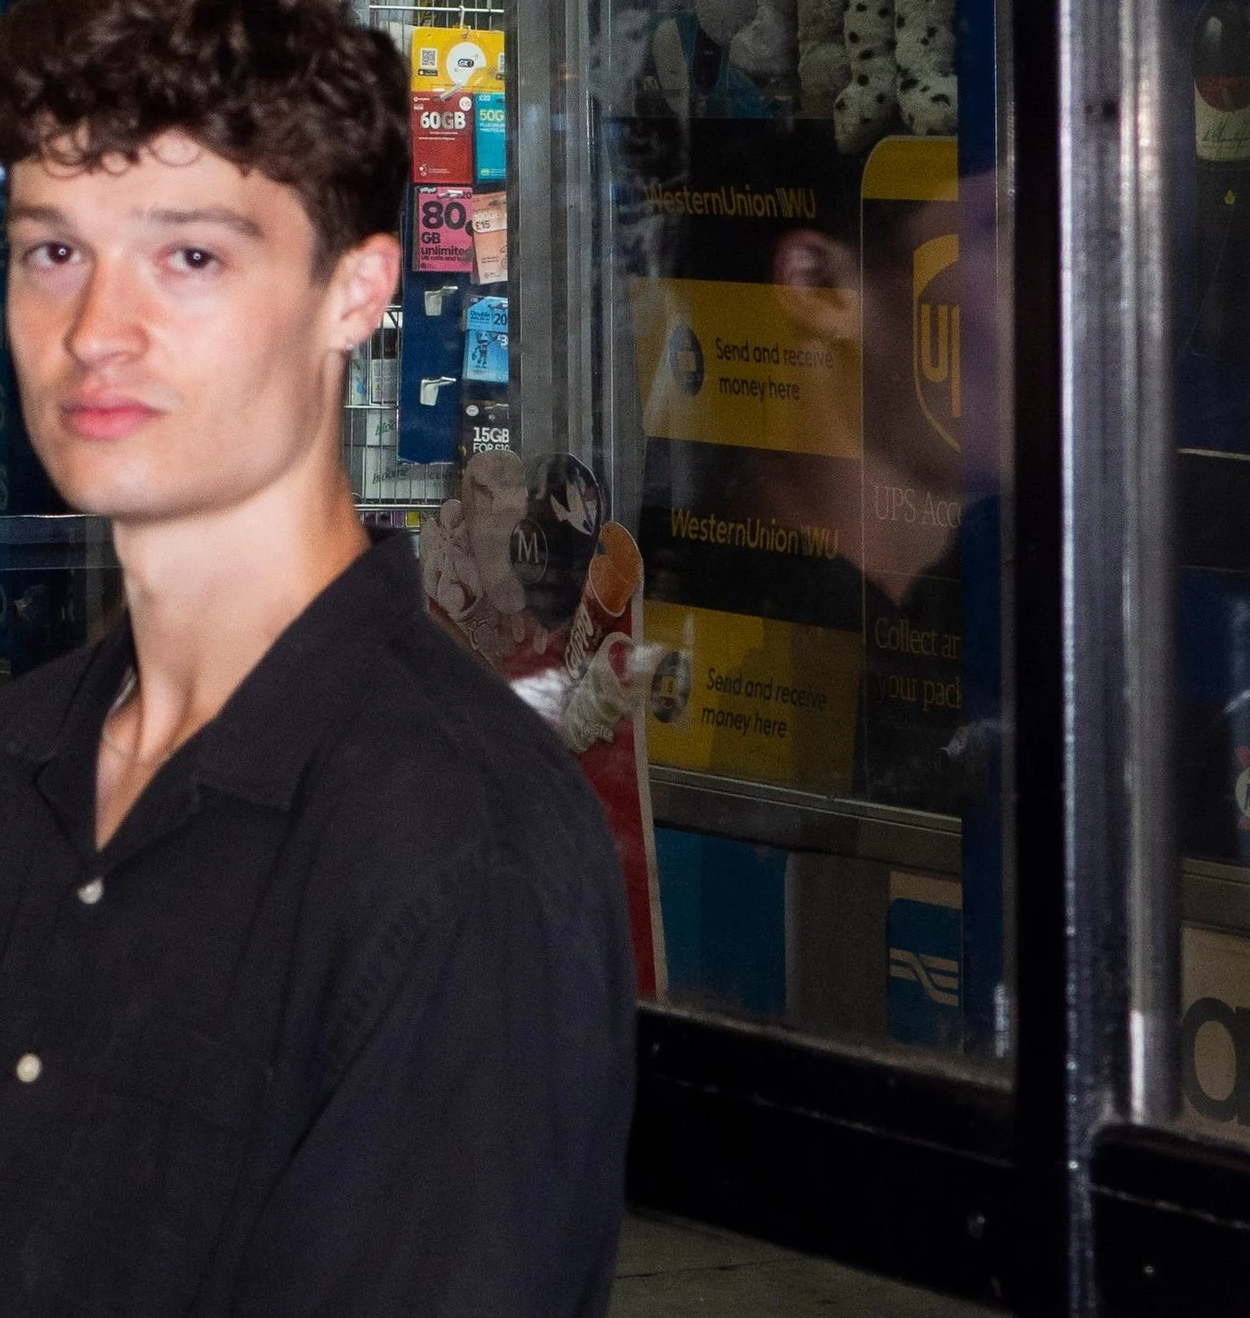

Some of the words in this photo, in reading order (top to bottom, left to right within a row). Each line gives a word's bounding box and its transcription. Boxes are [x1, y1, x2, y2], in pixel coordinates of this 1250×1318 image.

[420, 111, 467, 130] 60GB
[422, 200, 466, 230] 80
[643, 183, 778, 219] WesternUnion
[782, 188, 817, 219] WU
[421, 231, 441, 244] GB
[475, 219, 491, 231] £15
[716, 337, 749, 363] Send
[753, 343, 780, 366] and
[784, 349, 834, 368] receive
[719, 376, 766, 402] money
[768, 376, 801, 401] here
[473, 426, 510, 444] 15GB
[874, 484, 917, 524] UPS
[671, 507, 799, 555] WesternUnion
[805, 527, 840, 560] WU
[874, 616, 938, 657] Collect
[706, 667, 742, 696] Send
[745, 676, 773, 701] and
[775, 685, 827, 710] receive
[701, 707, 752, 736] money
[754, 711, 787, 739] here
